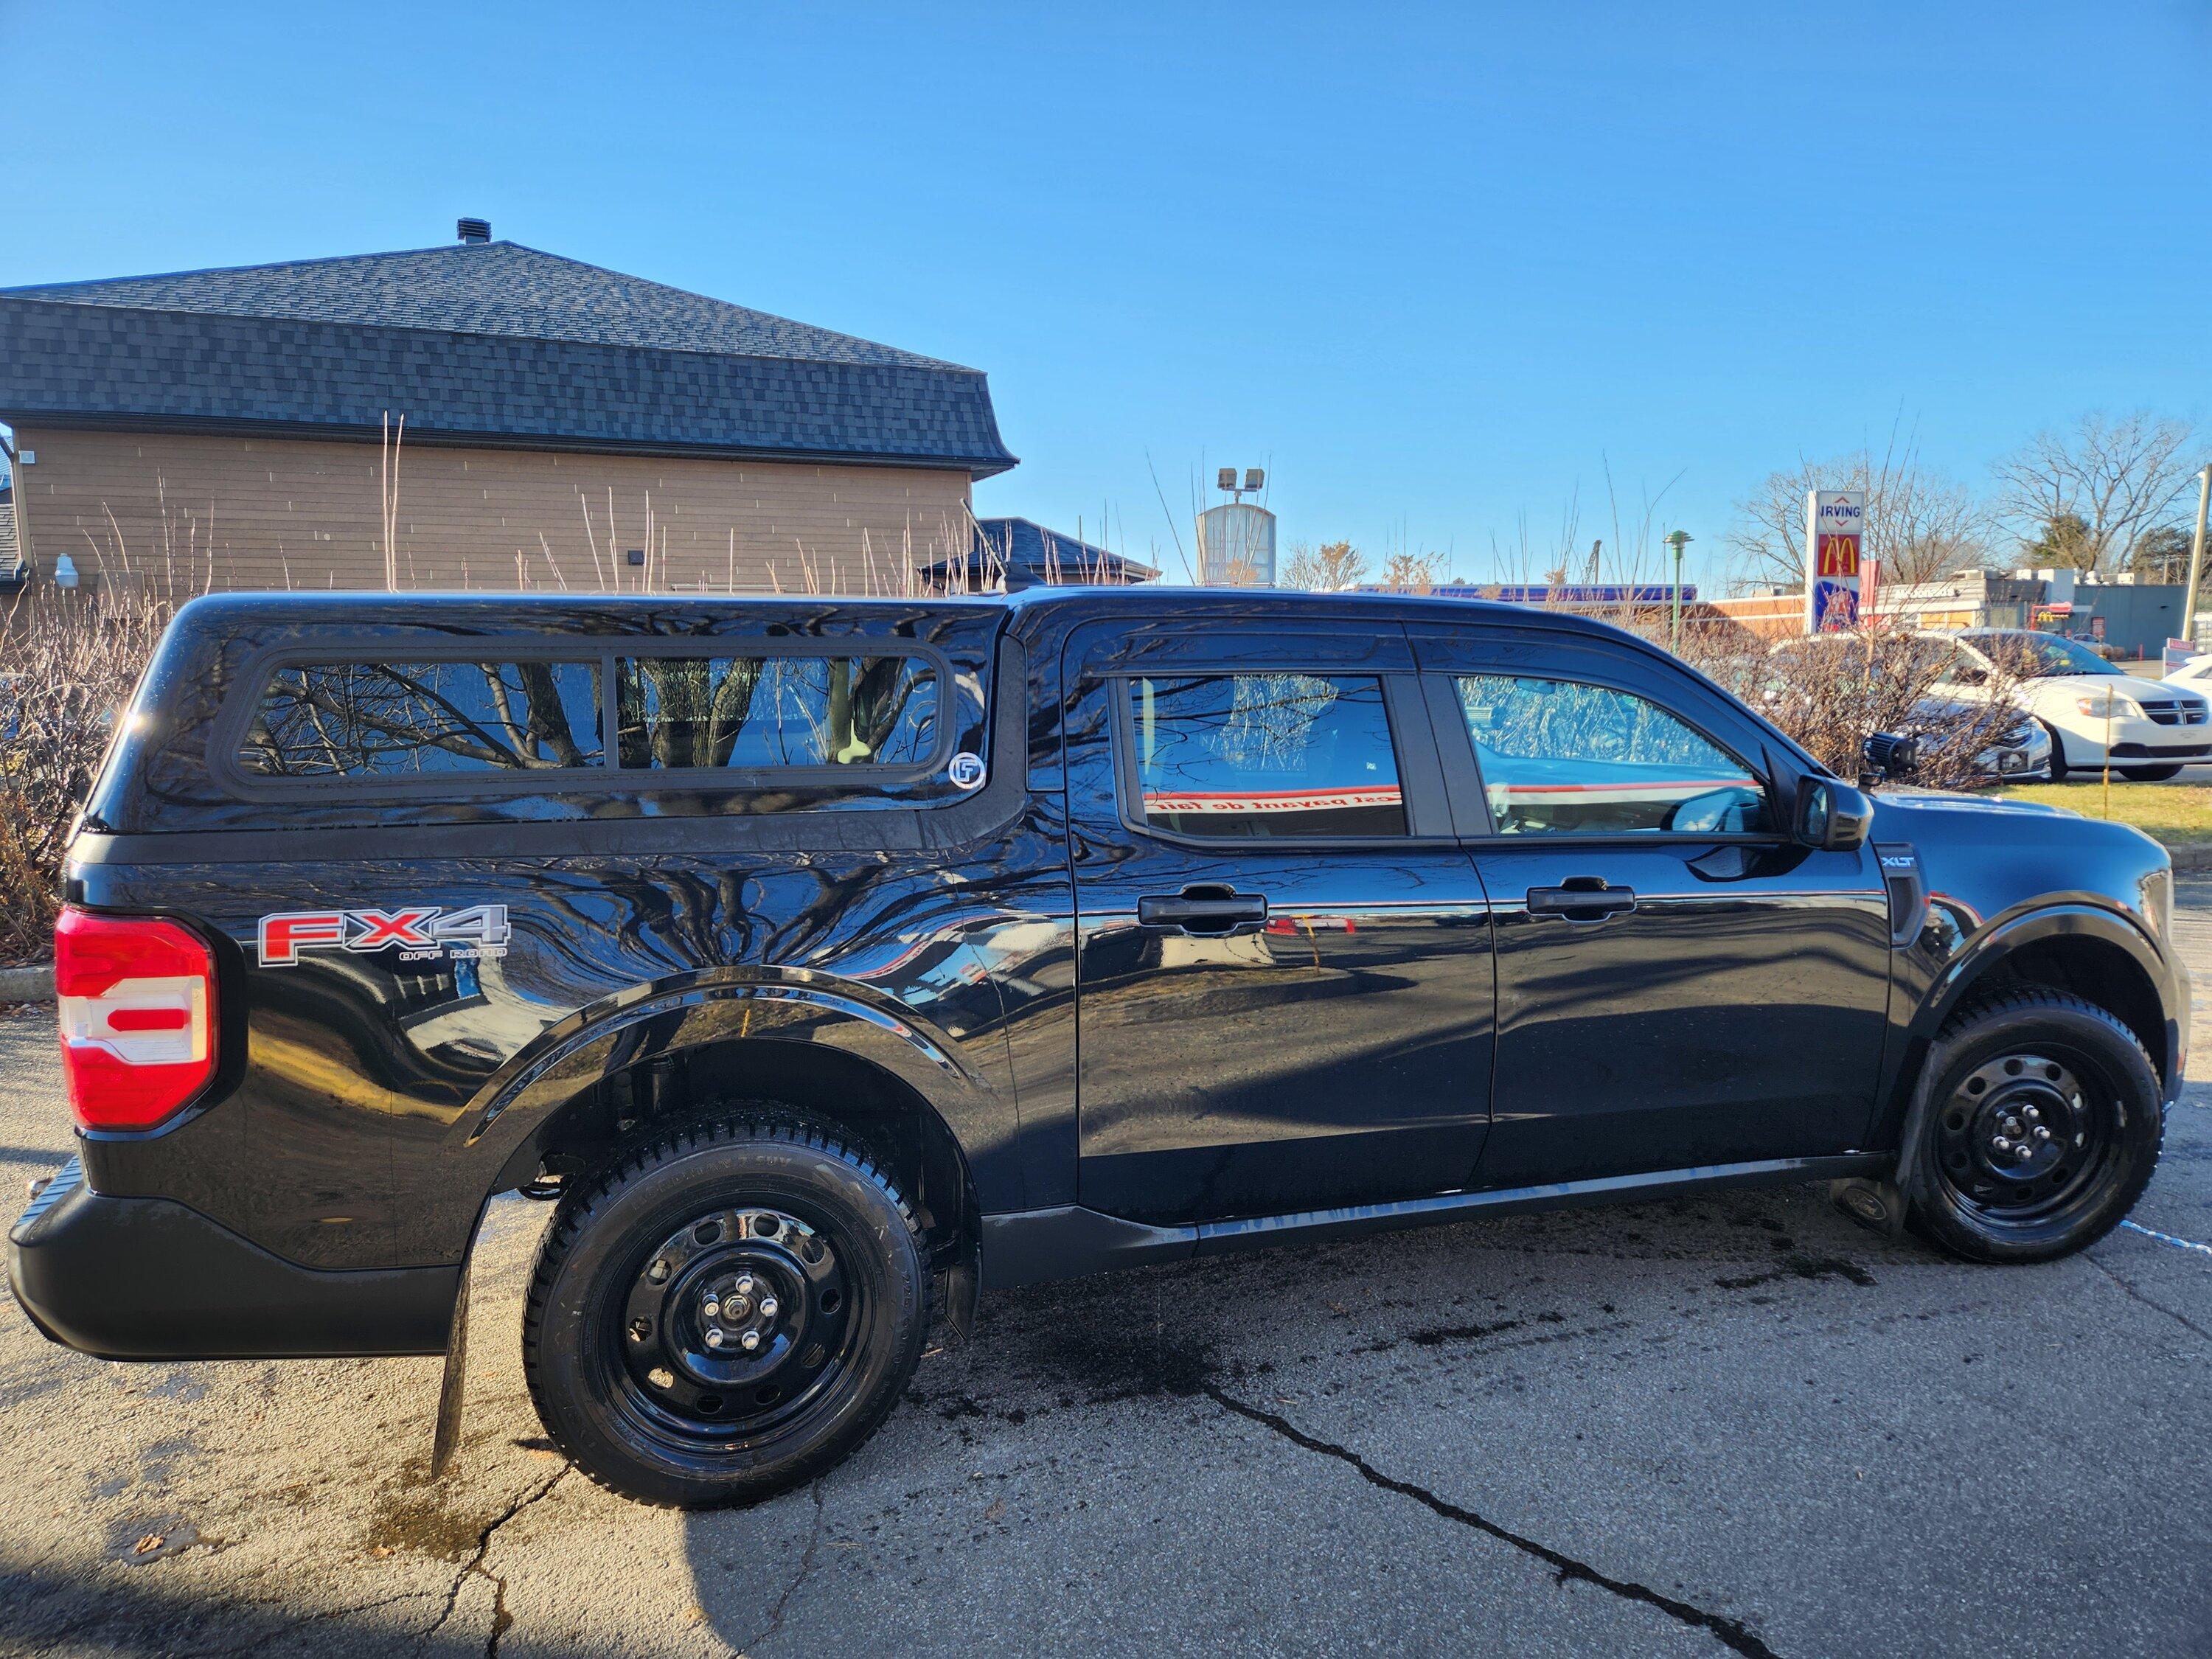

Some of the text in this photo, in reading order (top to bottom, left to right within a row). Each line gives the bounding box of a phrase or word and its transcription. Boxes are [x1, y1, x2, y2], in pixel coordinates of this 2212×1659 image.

[1820, 505, 1860, 518] IRVING
[1880, 856, 1914, 868] XLT
[258, 904, 511, 967] FX4
[399, 947, 508, 961] OFF ROAD
